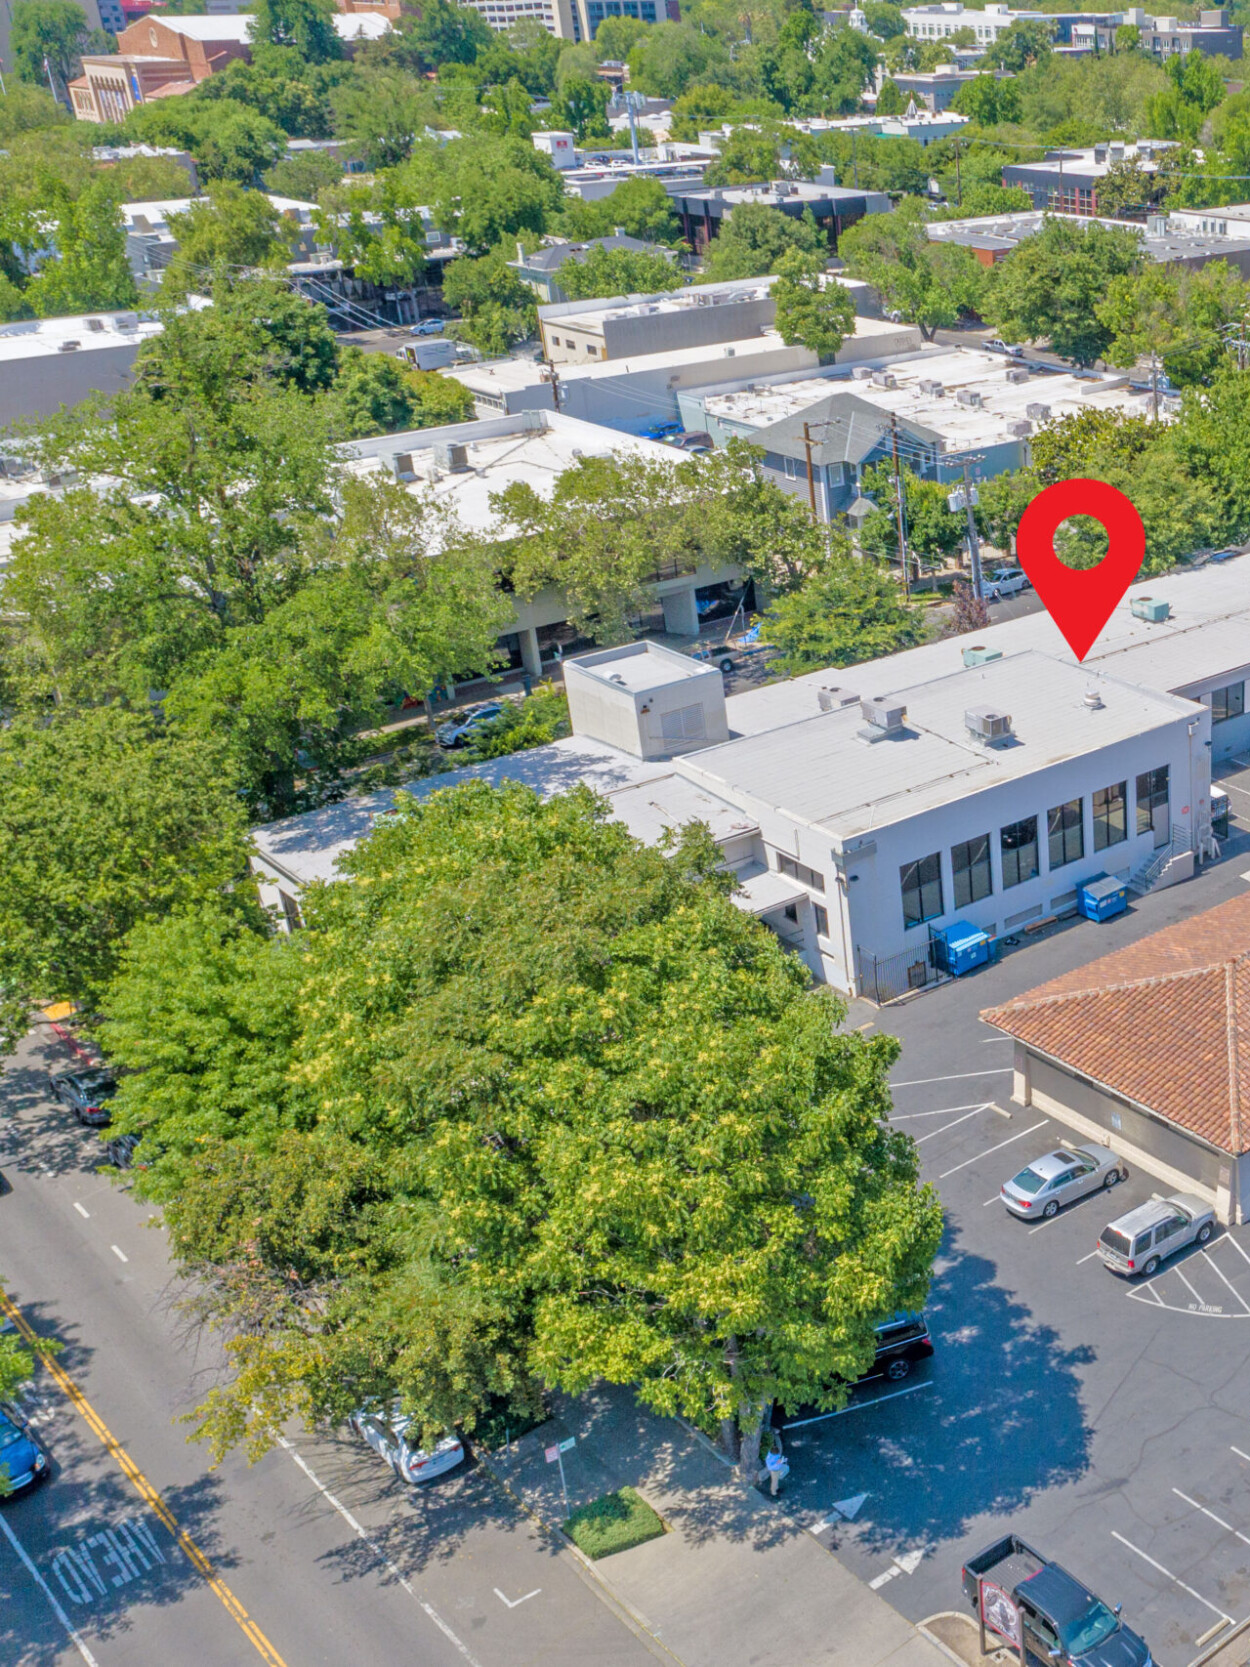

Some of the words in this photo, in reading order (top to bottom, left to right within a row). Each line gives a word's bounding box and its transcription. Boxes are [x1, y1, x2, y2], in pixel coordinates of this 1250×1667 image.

[1188, 1303, 1197, 1311] NO
[1199, 1303, 1223, 1314] PARKING
[52, 1518, 166, 1605] AHEAD
